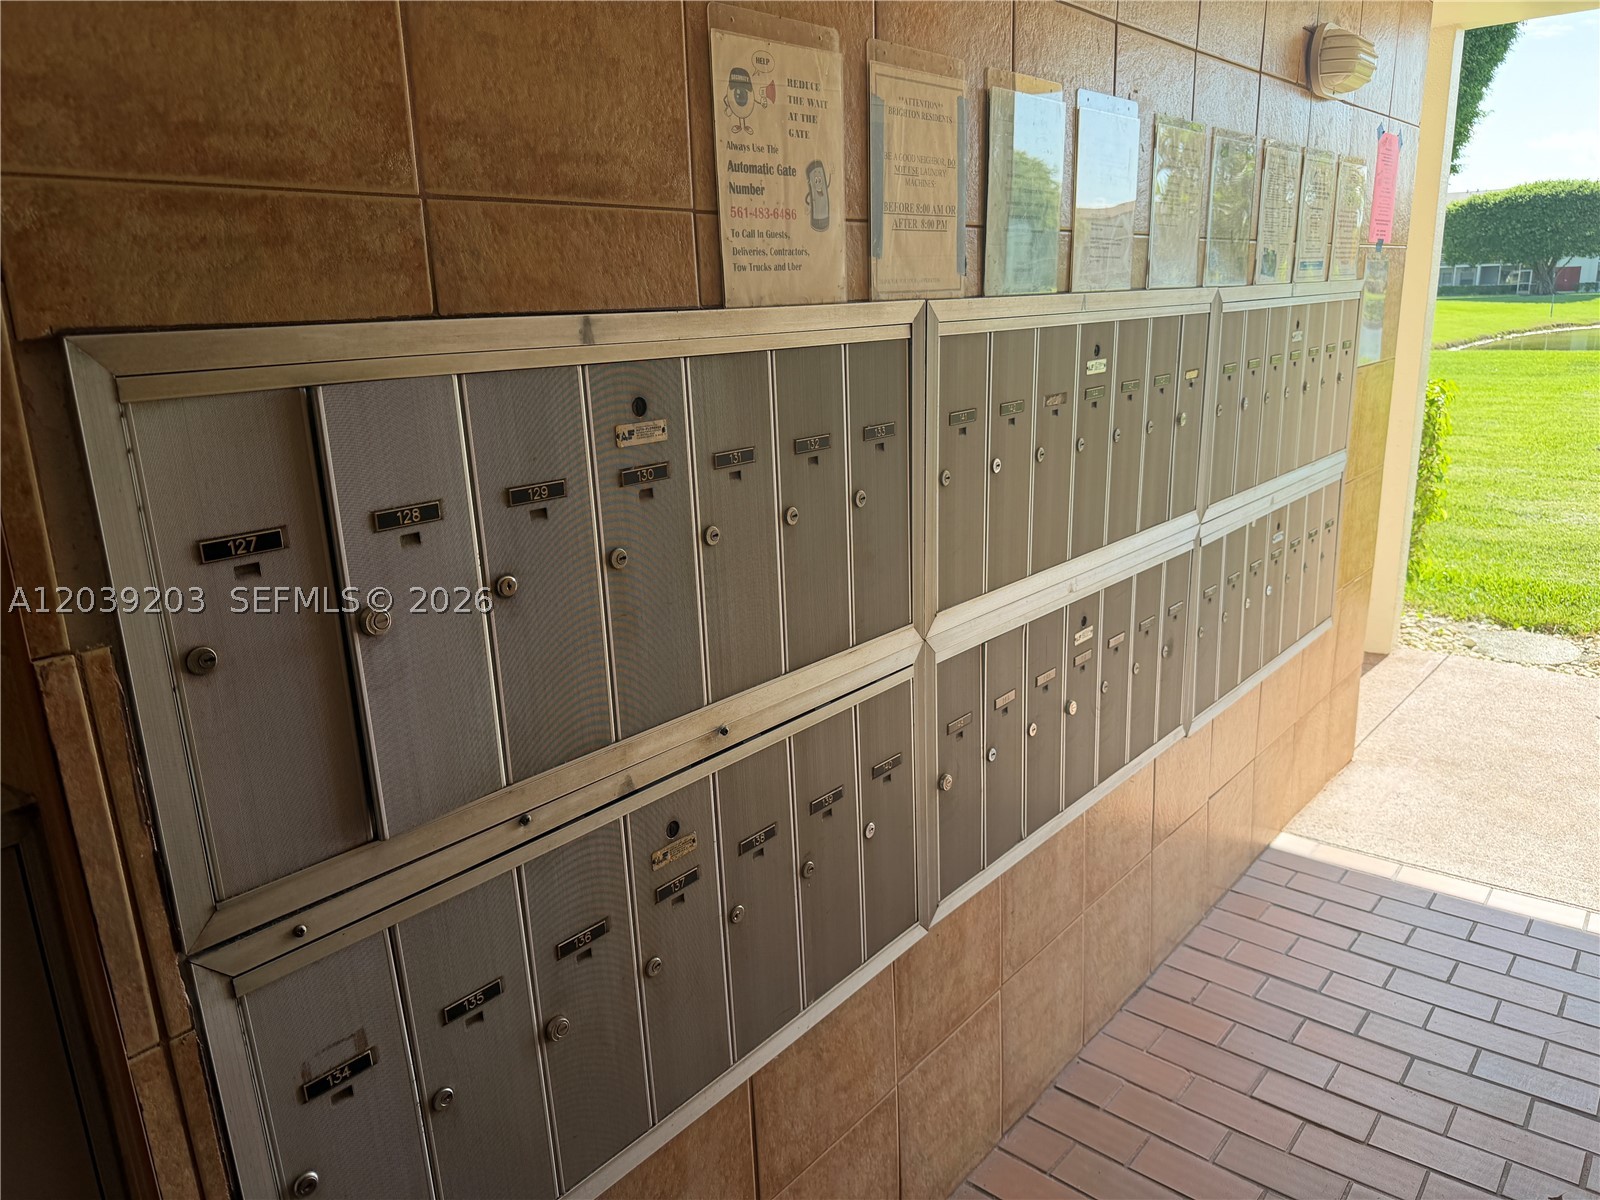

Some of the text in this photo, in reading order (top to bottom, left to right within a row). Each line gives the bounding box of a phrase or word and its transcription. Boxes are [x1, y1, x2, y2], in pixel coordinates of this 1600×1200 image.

[756, 57, 770, 66] HELP
[787, 78, 821, 92] REDUCE
[788, 95, 828, 109] THE WAIT
[788, 112, 818, 124] AT THE
[888, 106, 952, 124] BRIGHTON RESIDENTS
[788, 128, 810, 139] GATE
[726, 140, 778, 154] Always Use The
[728, 160, 796, 177] Automatic Gate
[948, 158, 956, 167] DO
[728, 182, 765, 196] Number
[730, 206, 796, 220] 561-483-6486
[884, 202, 956, 214] BEFORE 8:00 AM OR
[892, 218, 948, 230] AFTER 8:00 PM
[731, 228, 790, 240] To Call In Guests,
[732, 247, 810, 257] Deliveries, Contractors,
[733, 262, 802, 272] Tow Trucks and Uber
[874, 426, 886, 437] 133
[807, 438, 819, 449] 132
[729, 452, 742, 464] 131
[637, 468, 654, 482] 130
[528, 486, 548, 500] 129
[397, 508, 421, 525] 128
[226, 536, 257, 556] 127
[752, 832, 765, 846] 138
[671, 877, 685, 893] 137
[573, 931, 592, 948] 136
[464, 992, 485, 1011] 135
[326, 1067, 351, 1087] 134
